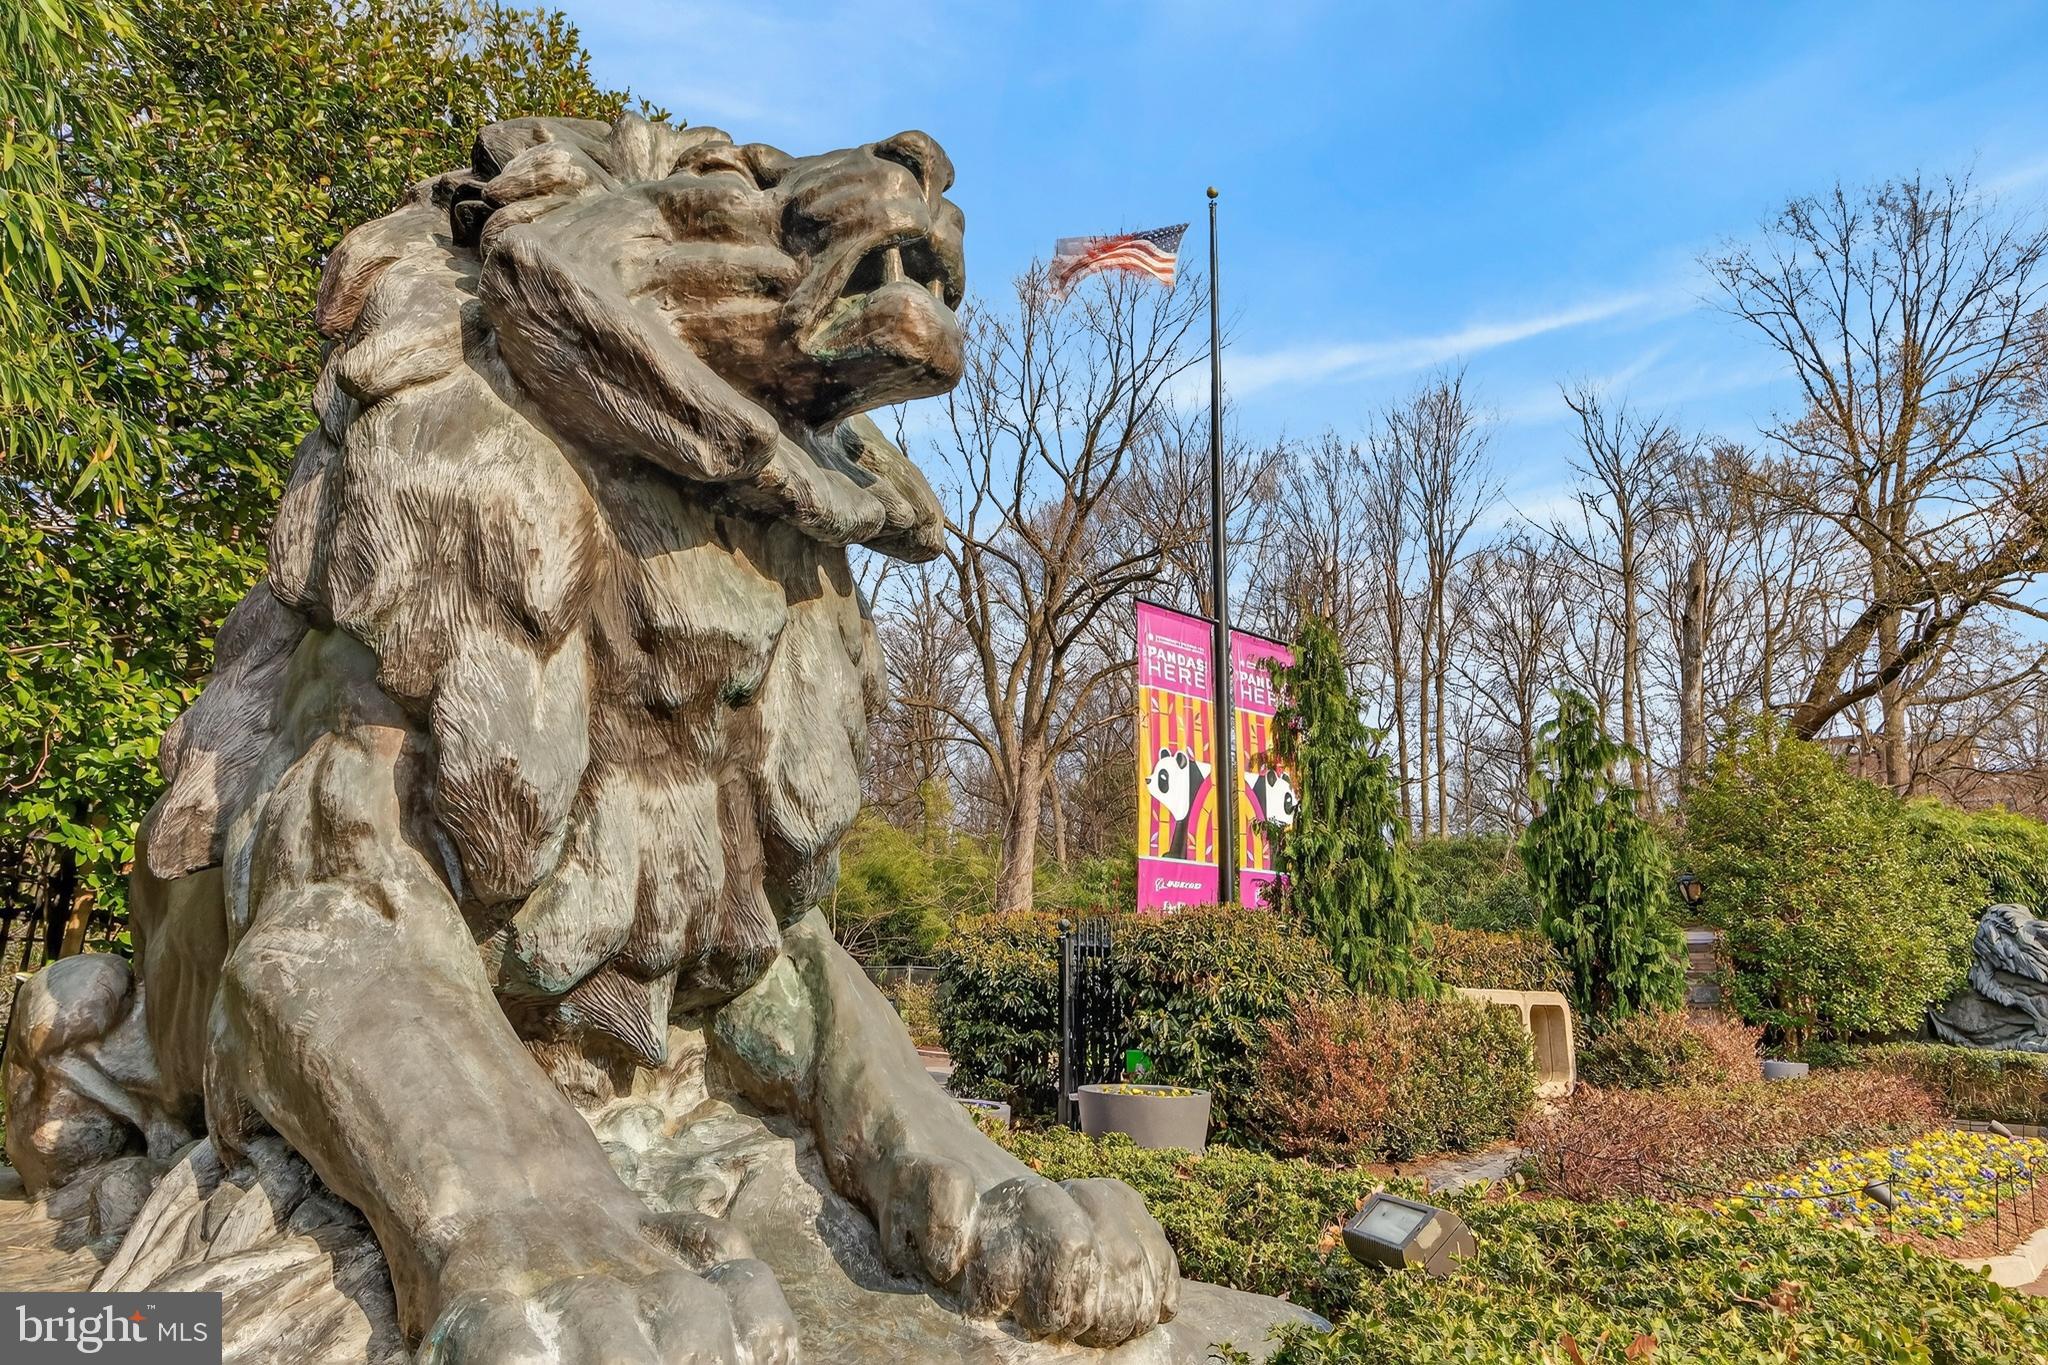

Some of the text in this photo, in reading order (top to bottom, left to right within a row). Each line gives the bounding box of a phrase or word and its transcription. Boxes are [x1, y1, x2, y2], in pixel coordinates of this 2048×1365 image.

[1147, 645, 1205, 672] PANDAS
[1148, 660, 1206, 690] HERE
[1240, 671, 1273, 691] PAND
